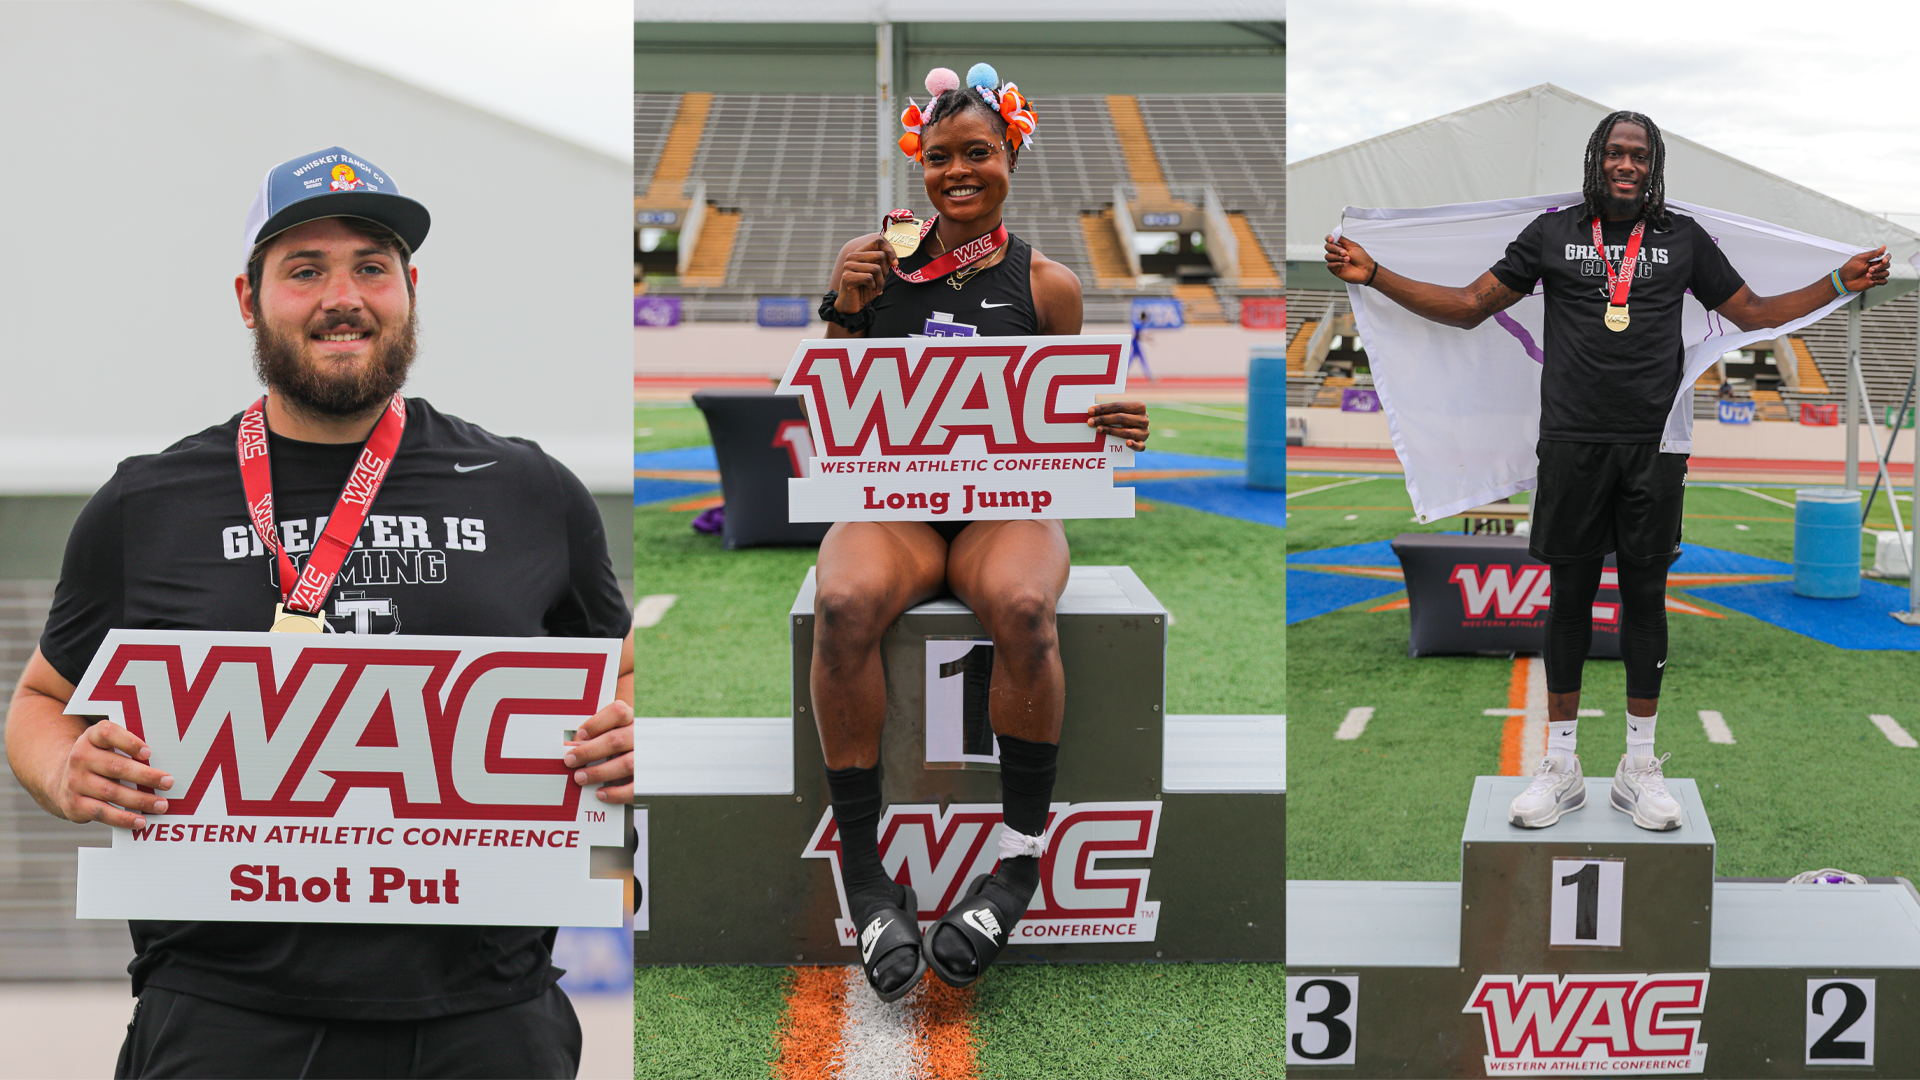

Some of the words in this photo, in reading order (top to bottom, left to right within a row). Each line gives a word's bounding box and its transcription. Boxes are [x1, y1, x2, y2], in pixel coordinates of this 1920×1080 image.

[293, 154, 338, 177] WHISKEY
[341, 154, 372, 174] RANCH
[373, 172, 385, 184] CO
[953, 233, 993, 263] WAC
[1651, 247, 1669, 265] IS
[1618, 256, 1635, 283] WAC
[790, 344, 1122, 457] WAC
[1720, 404, 1750, 420] UTA
[241, 411, 268, 459] WAC
[1109, 445, 1123, 453] TM
[341, 448, 384, 504] WAC
[821, 461, 901, 473] WESTERN
[906, 459, 988, 472] ATHLETIC
[993, 457, 1106, 471] CONFERENCE
[863, 486, 950, 514] Long
[963, 484, 1052, 514] Jump
[443, 517, 486, 552] IS
[1462, 620, 1506, 628] WESTERN
[1508, 620, 1545, 628] ATHLET
[939, 644, 994, 756] 1
[88, 644, 608, 822] WAC
[585, 811, 605, 823] TM
[132, 823, 257, 842] WESTERN
[264, 825, 394, 845] ATHLETIC
[402, 827, 580, 848] CONFERENCE
[230, 864, 350, 903] Shot
[369, 867, 459, 904] Put
[1140, 910, 1155, 919] TM
[1561, 863, 1600, 940] 1
[861, 916, 882, 949] NIKE
[976, 907, 1003, 940] NIKE
[1022, 923, 1138, 938] CONFERENCE
[1291, 979, 1352, 1060] 3
[1471, 979, 1704, 1058] WAC
[1809, 981, 1867, 1060] 2
[1490, 1061, 1547, 1071] WESTERN
[1550, 1060, 1608, 1070] ATHLETIC
[1612, 1059, 1691, 1070] CONFERENCE
